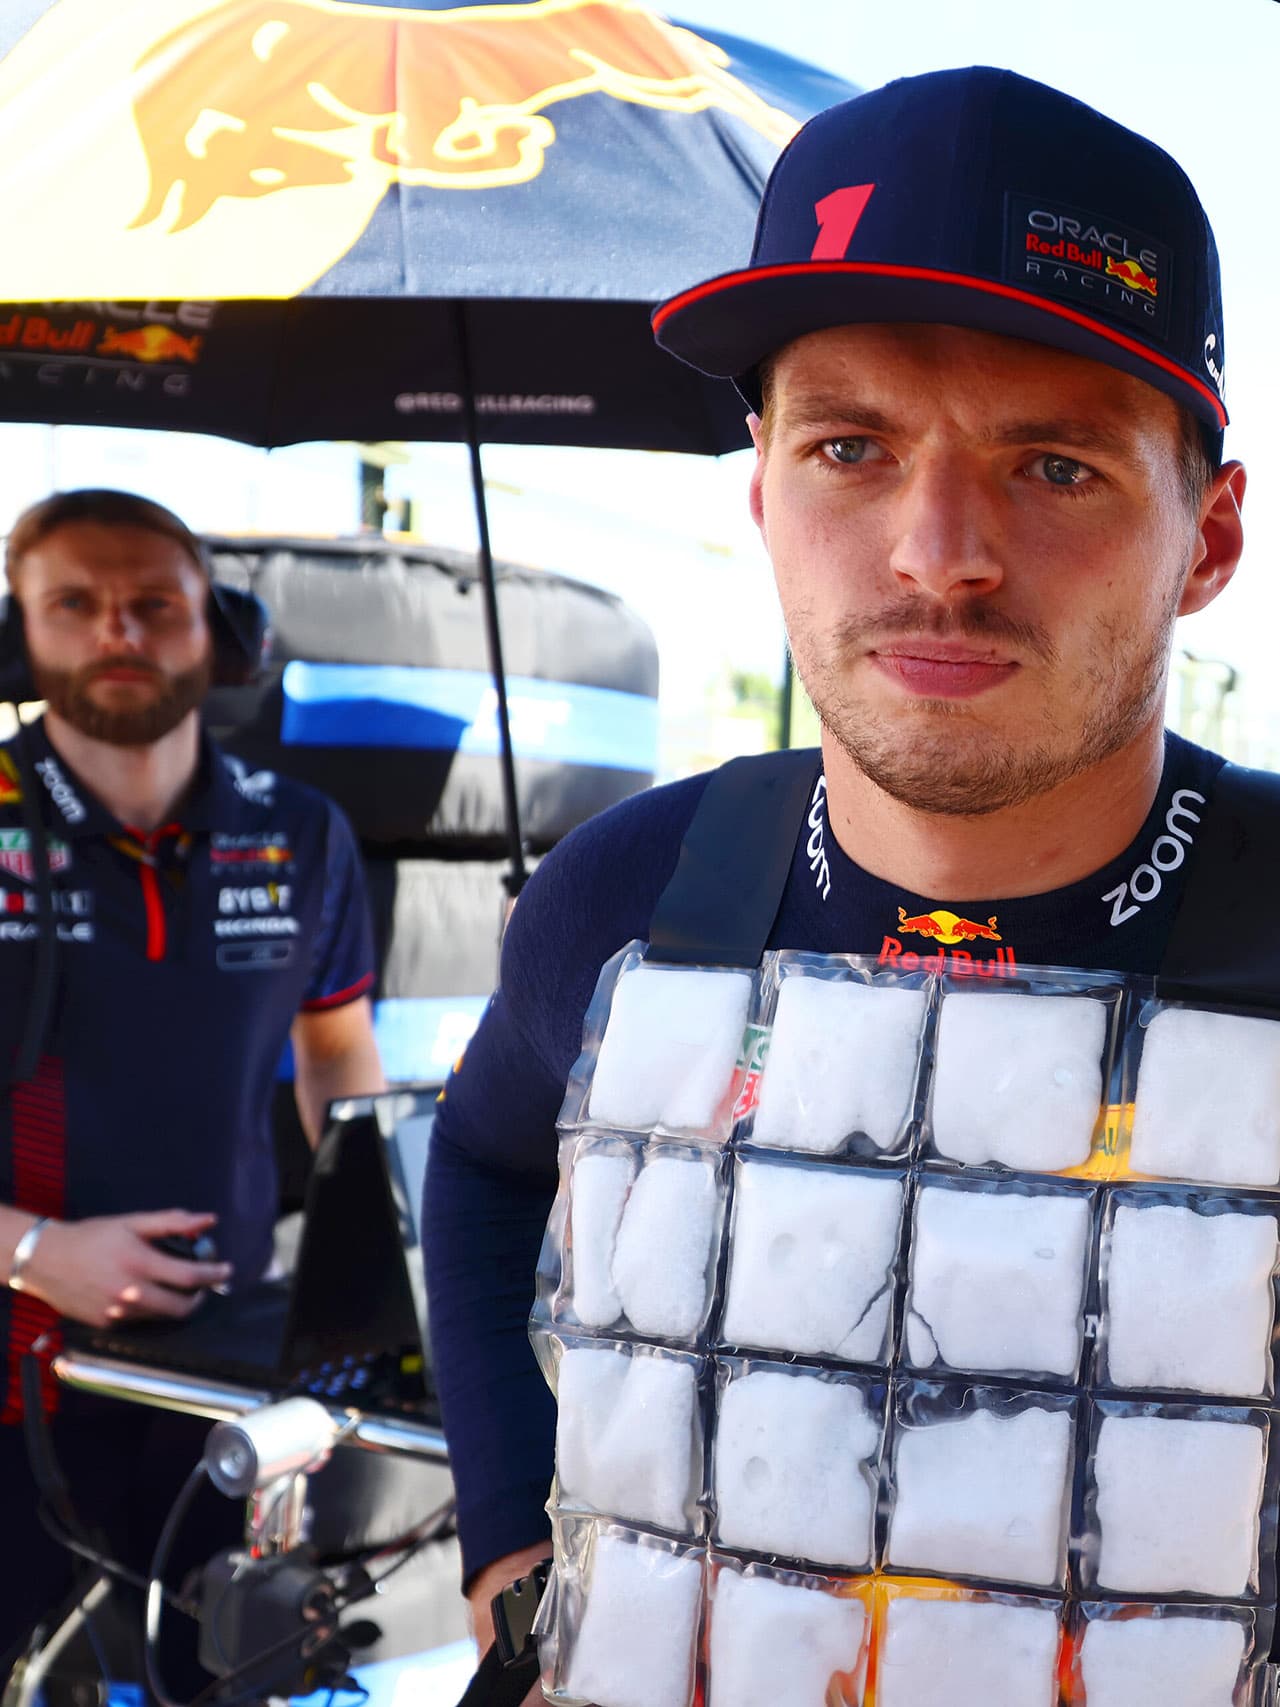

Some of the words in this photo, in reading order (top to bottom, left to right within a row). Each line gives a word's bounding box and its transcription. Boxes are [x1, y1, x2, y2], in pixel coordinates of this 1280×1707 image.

[810, 183, 875, 261] 1
[1026, 232, 1065, 258] Red
[1066, 243, 1102, 270] Bull
[1027, 210, 1157, 273] ORACLE
[1026, 261, 1156, 316] RACING
[1101, 789, 1206, 927] zoom
[877, 935, 945, 977] Red
[951, 946, 1018, 979] Bull
